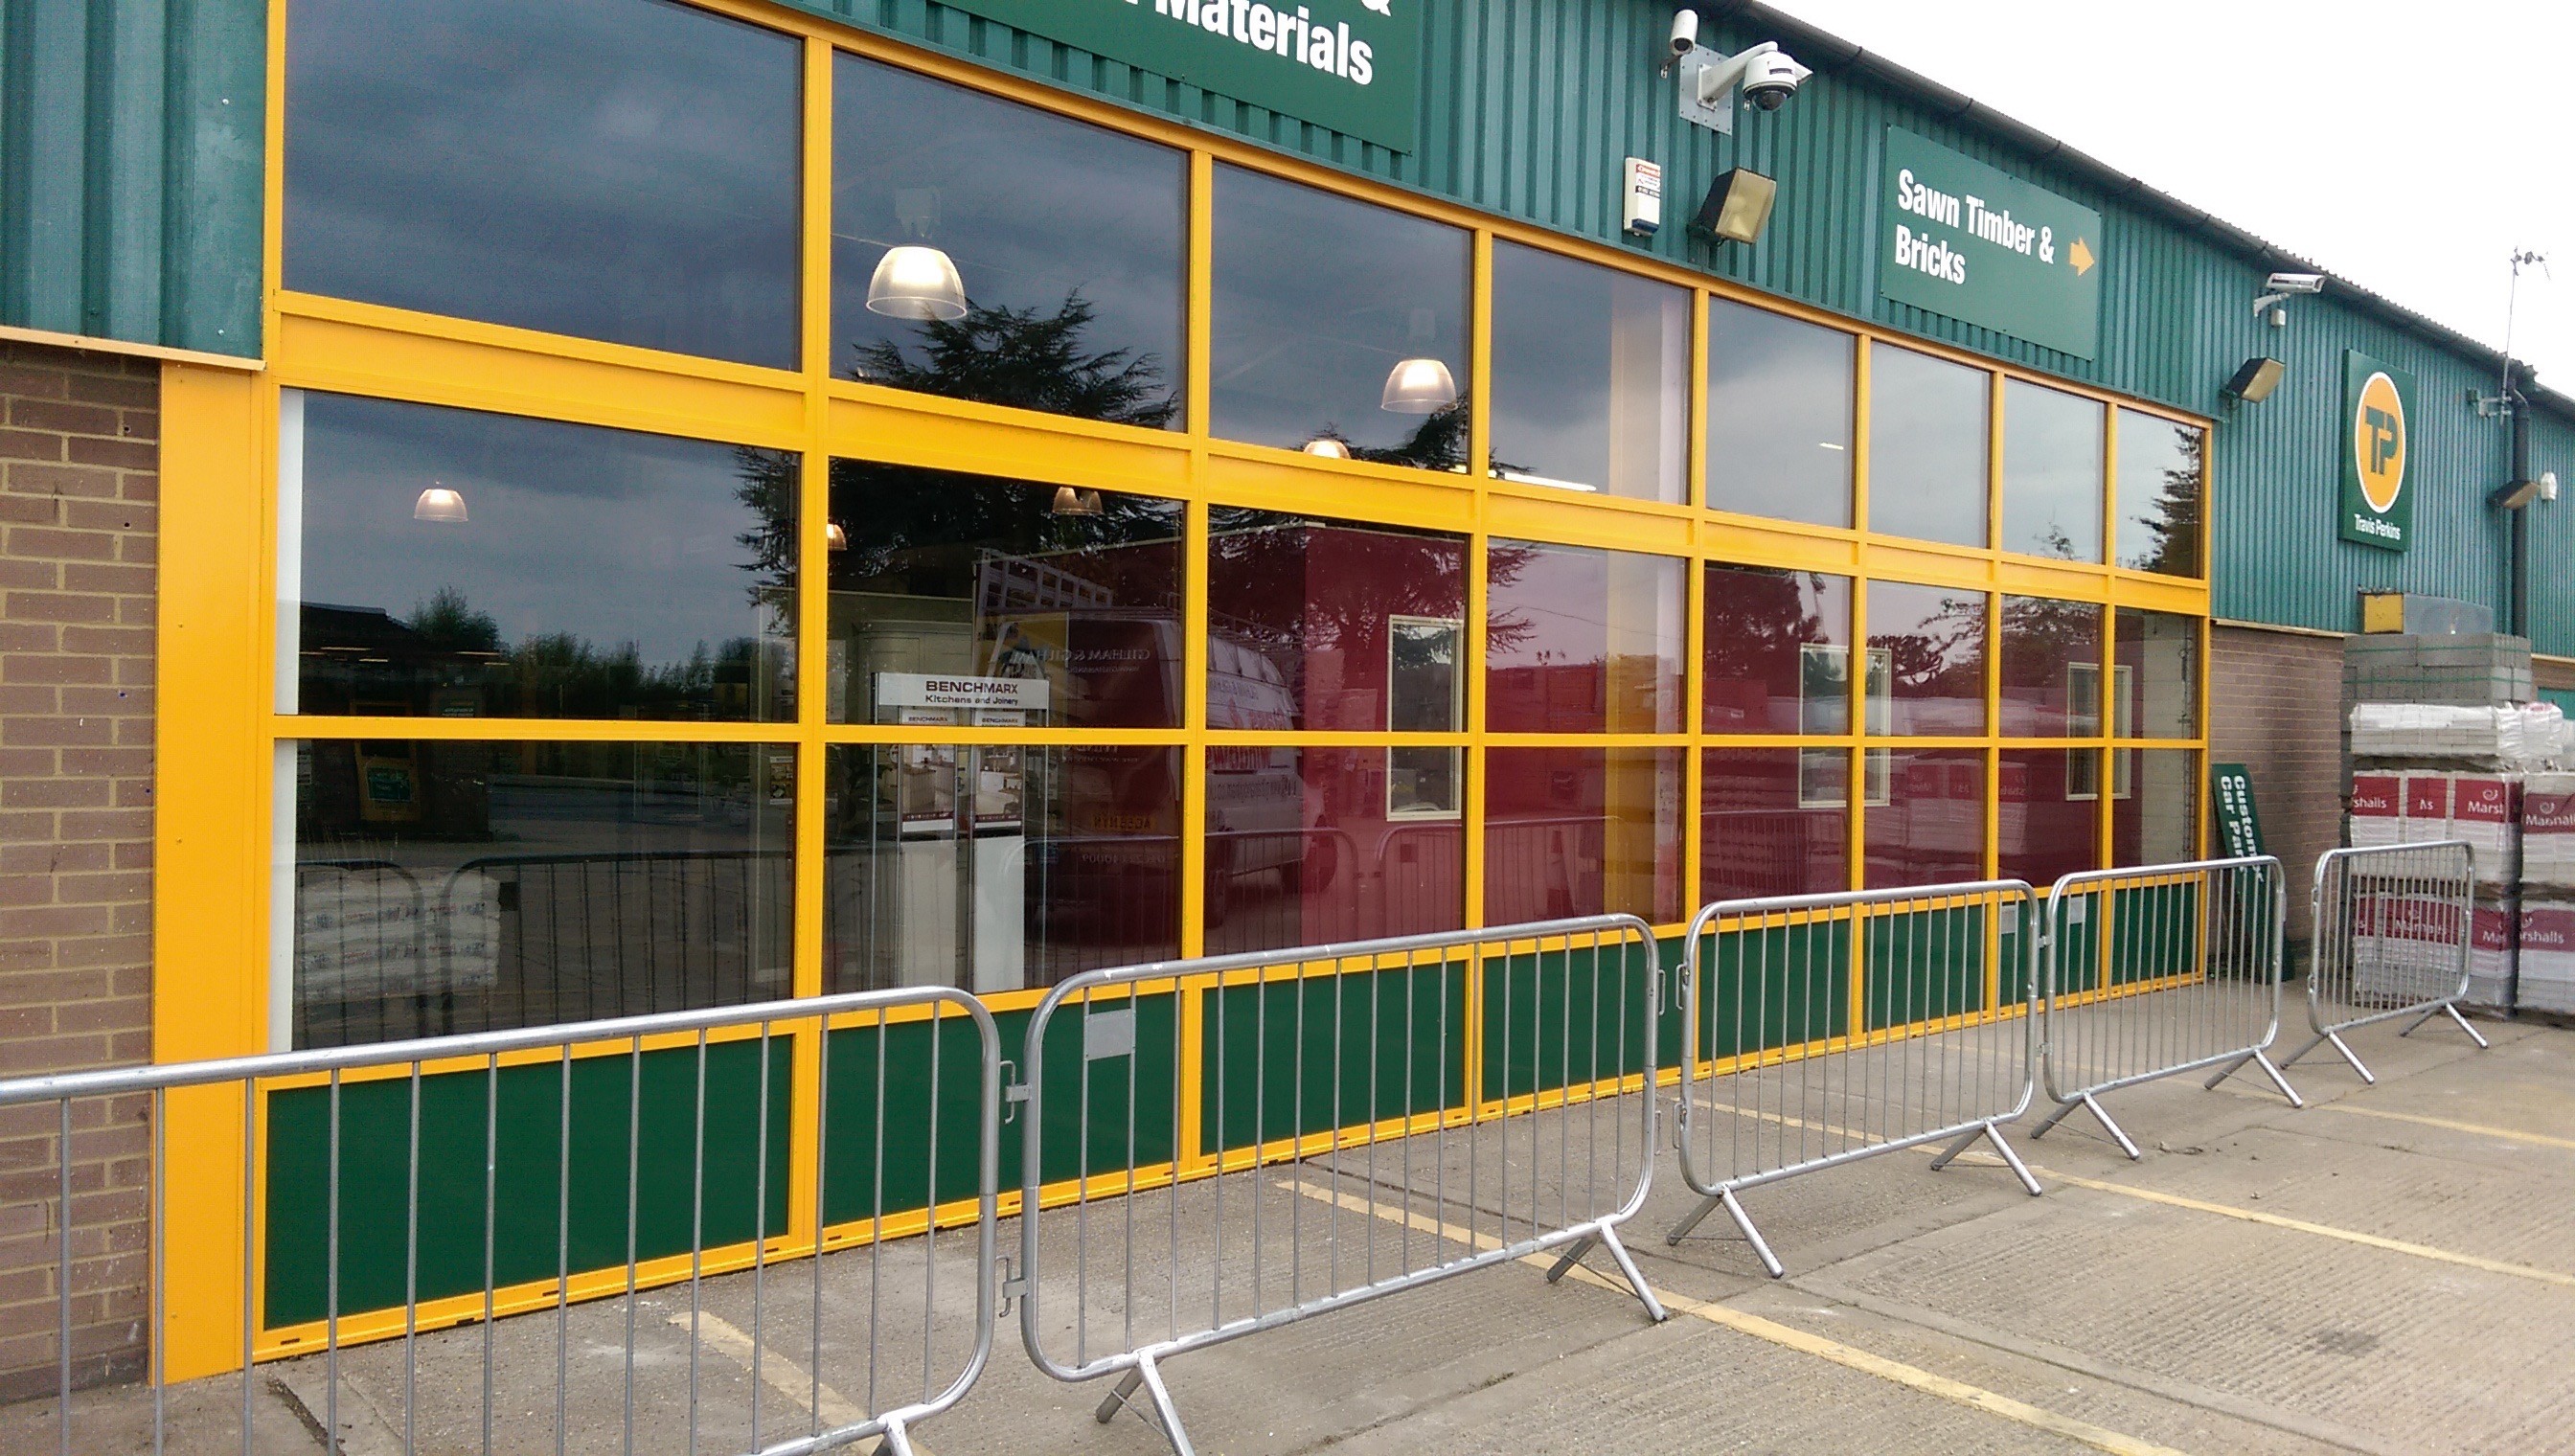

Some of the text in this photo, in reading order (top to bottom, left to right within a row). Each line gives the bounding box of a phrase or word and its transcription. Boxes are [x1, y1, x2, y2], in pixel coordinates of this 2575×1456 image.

[1898, 169, 2054, 264] Sawn Timber &
[1895, 224, 1966, 284] Bricks
[2365, 405, 2399, 475] TP
[2354, 513, 2402, 540] Travis Perkins
[925, 680, 1018, 694] BENCHMARX
[925, 694, 971, 704] Kitchens
[992, 697, 1018, 706] Joinery
[2221, 776, 2236, 814] Car
